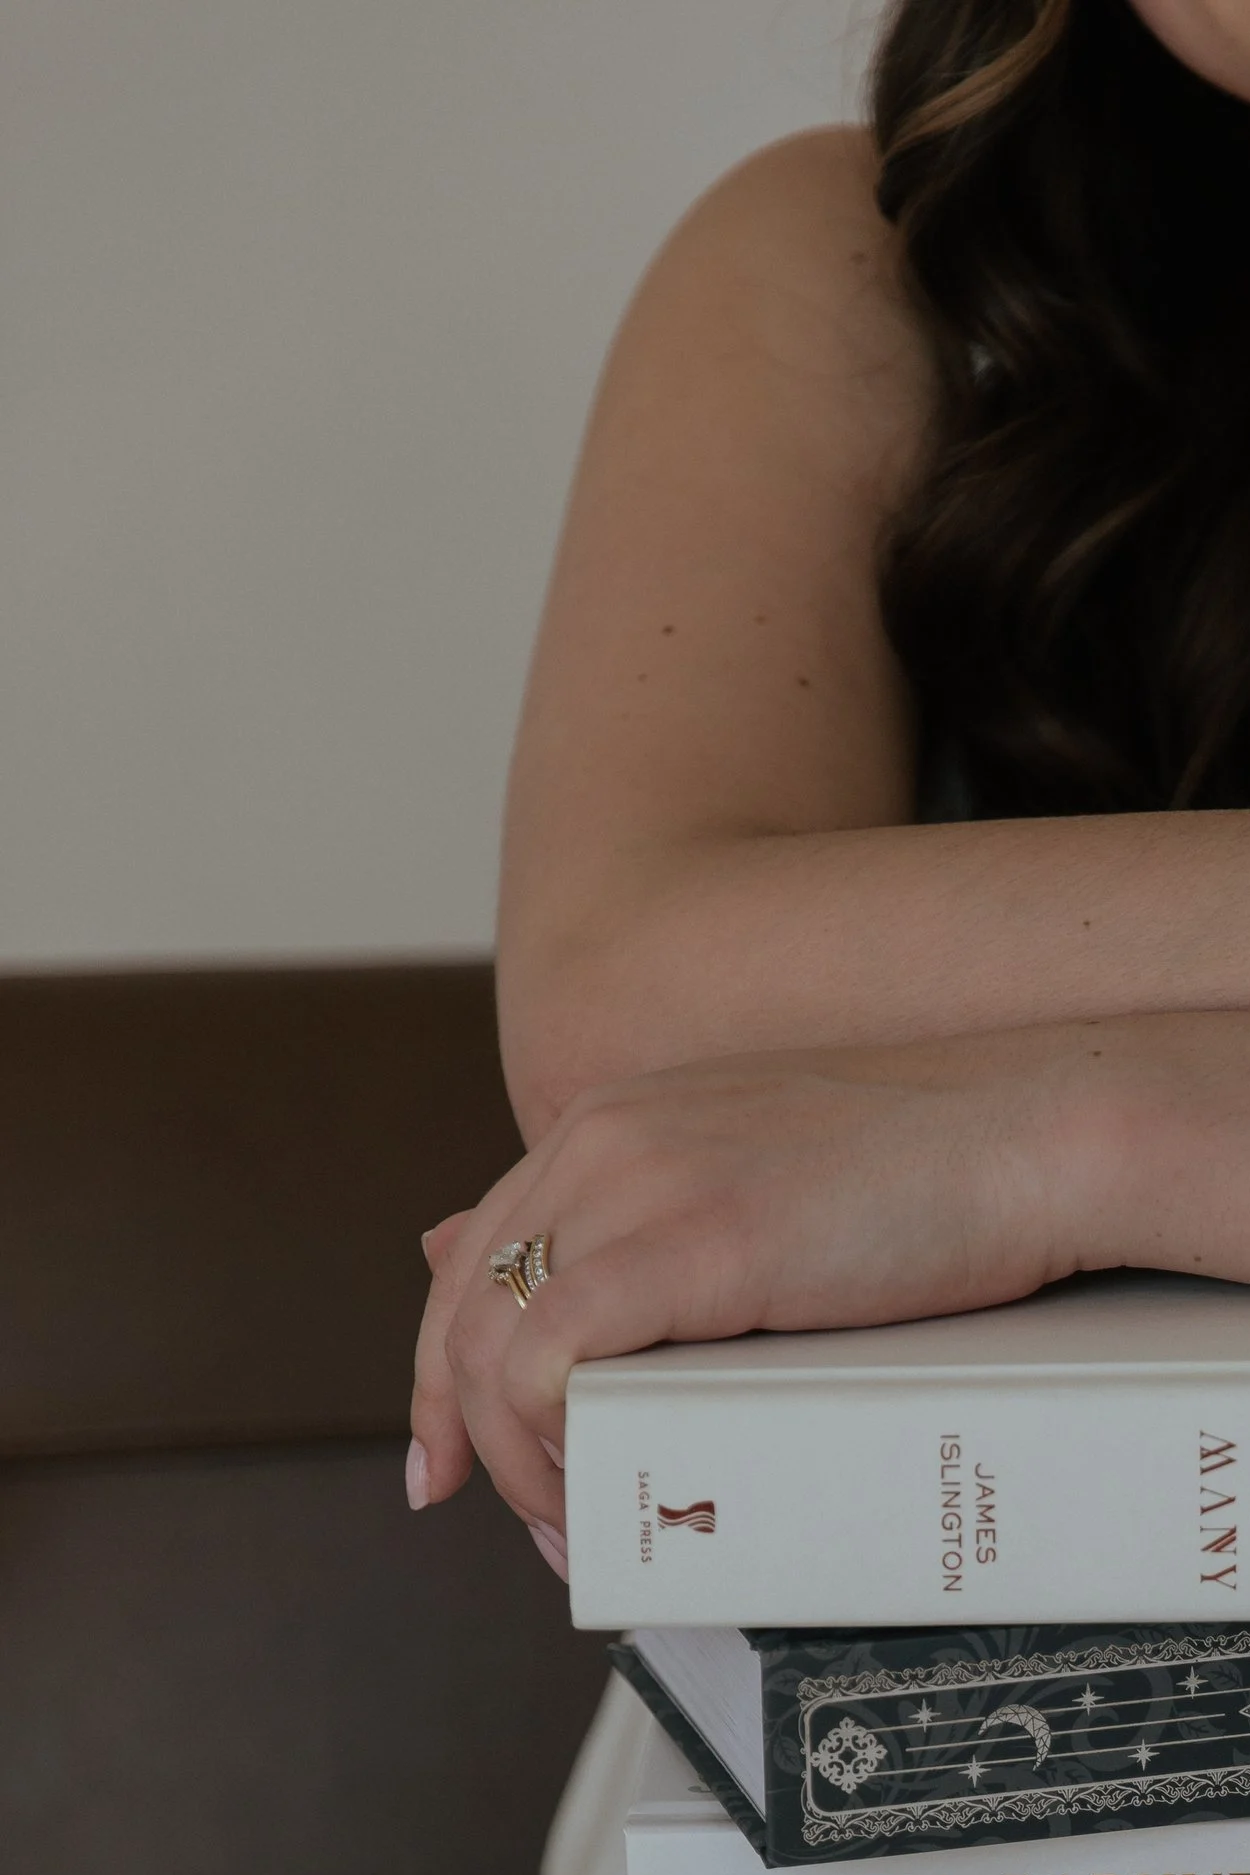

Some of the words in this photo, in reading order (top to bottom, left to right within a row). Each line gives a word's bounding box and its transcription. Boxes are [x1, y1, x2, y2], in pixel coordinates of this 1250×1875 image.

[637, 1470, 651, 1512] SAGA
[639, 1520, 653, 1564] PRESS
[939, 1434, 963, 1592] ISLINGTON
[974, 1462, 997, 1565] JAMES
[1199, 1430, 1238, 1591] MANY
